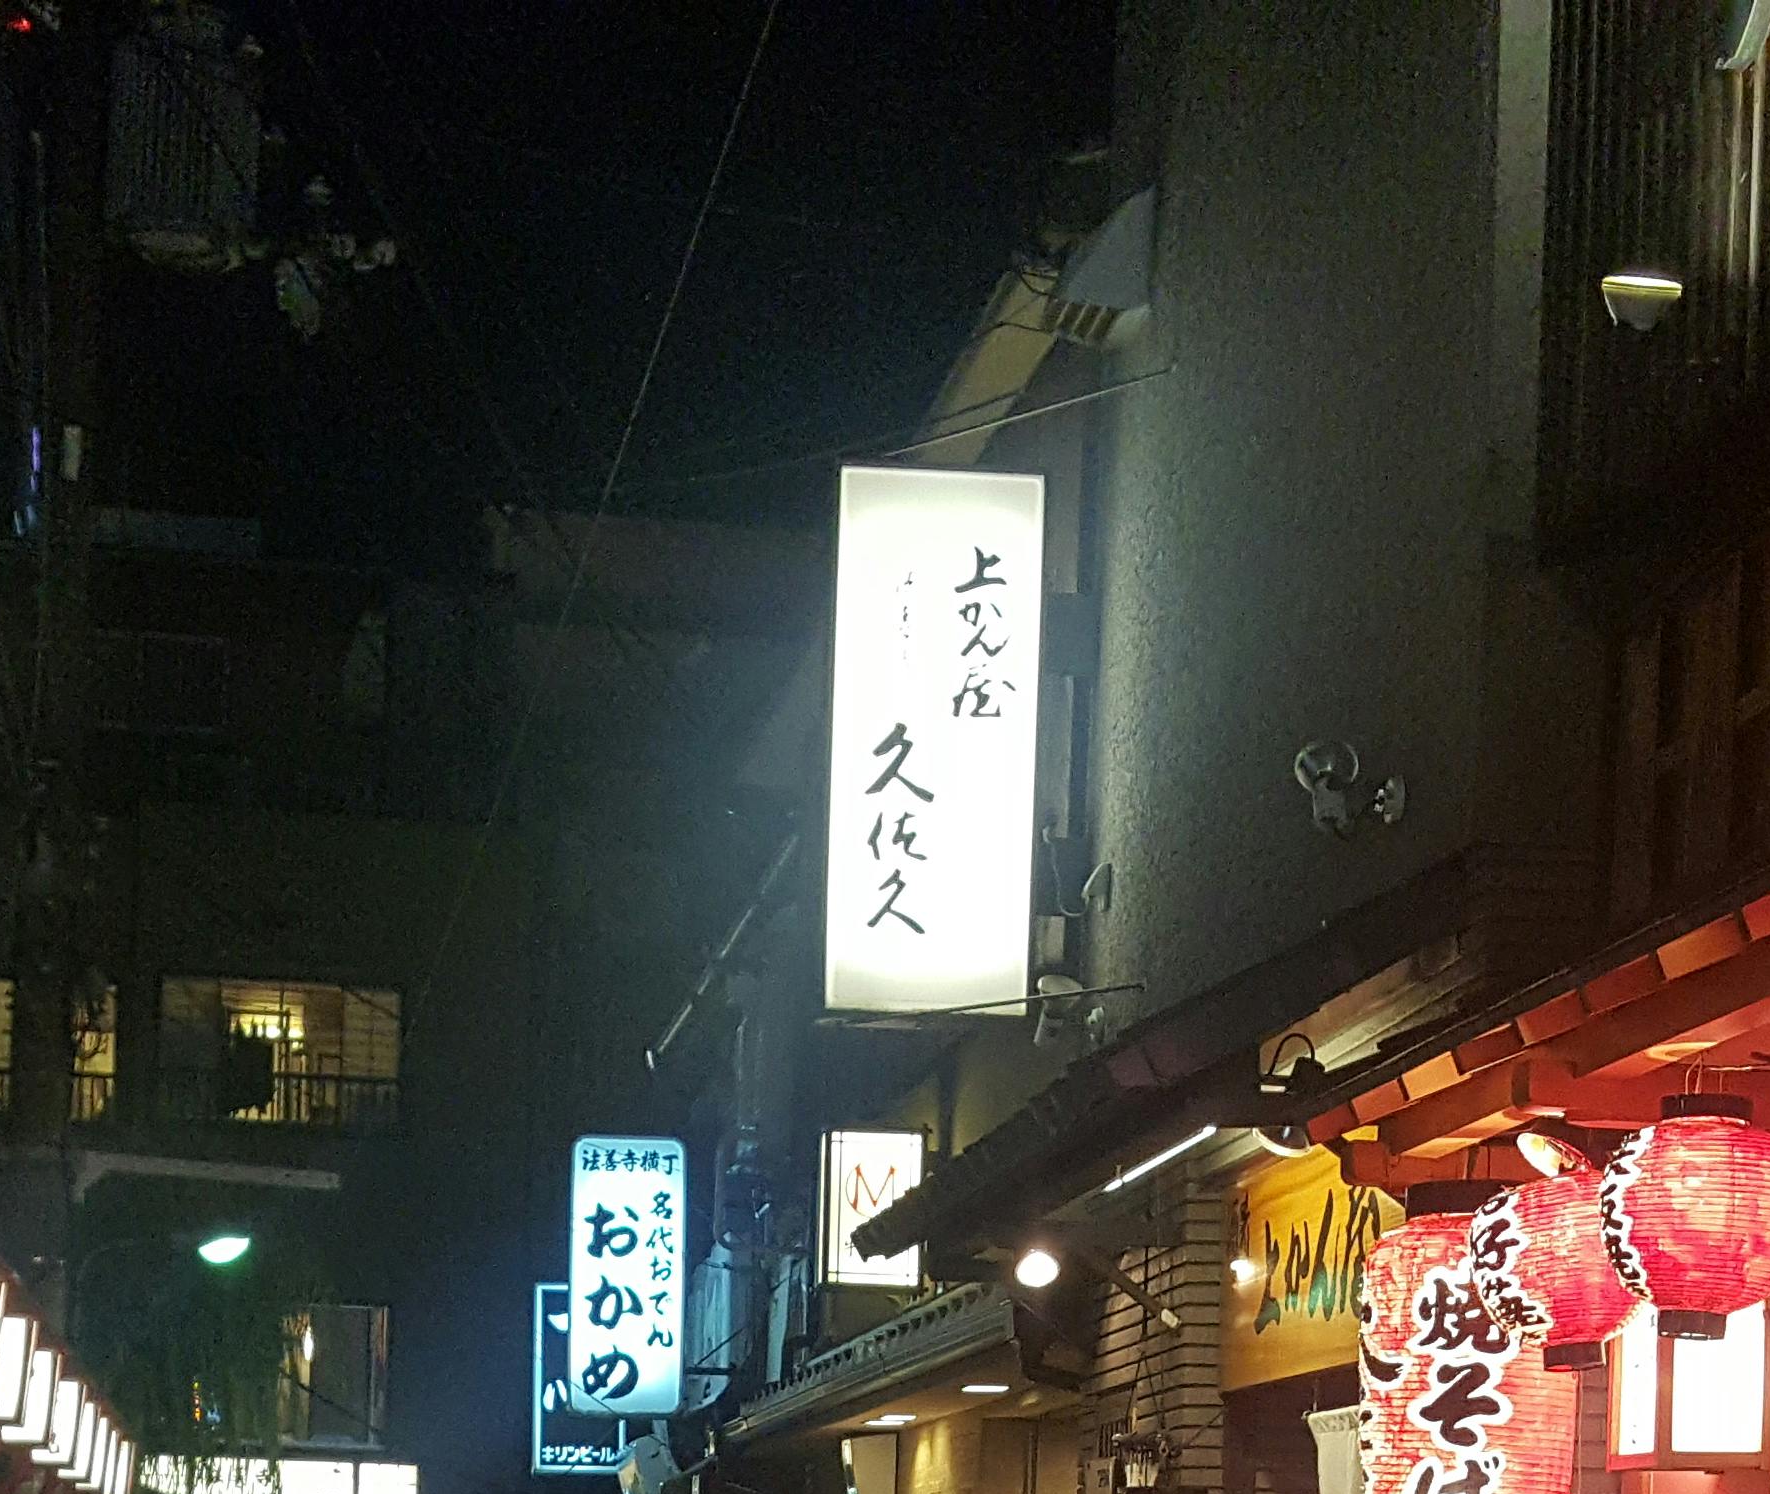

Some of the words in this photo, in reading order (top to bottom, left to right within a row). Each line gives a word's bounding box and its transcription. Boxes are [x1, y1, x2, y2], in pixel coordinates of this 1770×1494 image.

[865, 722, 935, 935] 久佐久
[582, 1149, 680, 1176] 法善寺横丁
[582, 1203, 643, 1399] おかめ
[646, 1190, 674, 1348] 名代おでん
[541, 1445, 615, 1463] キリンビール
